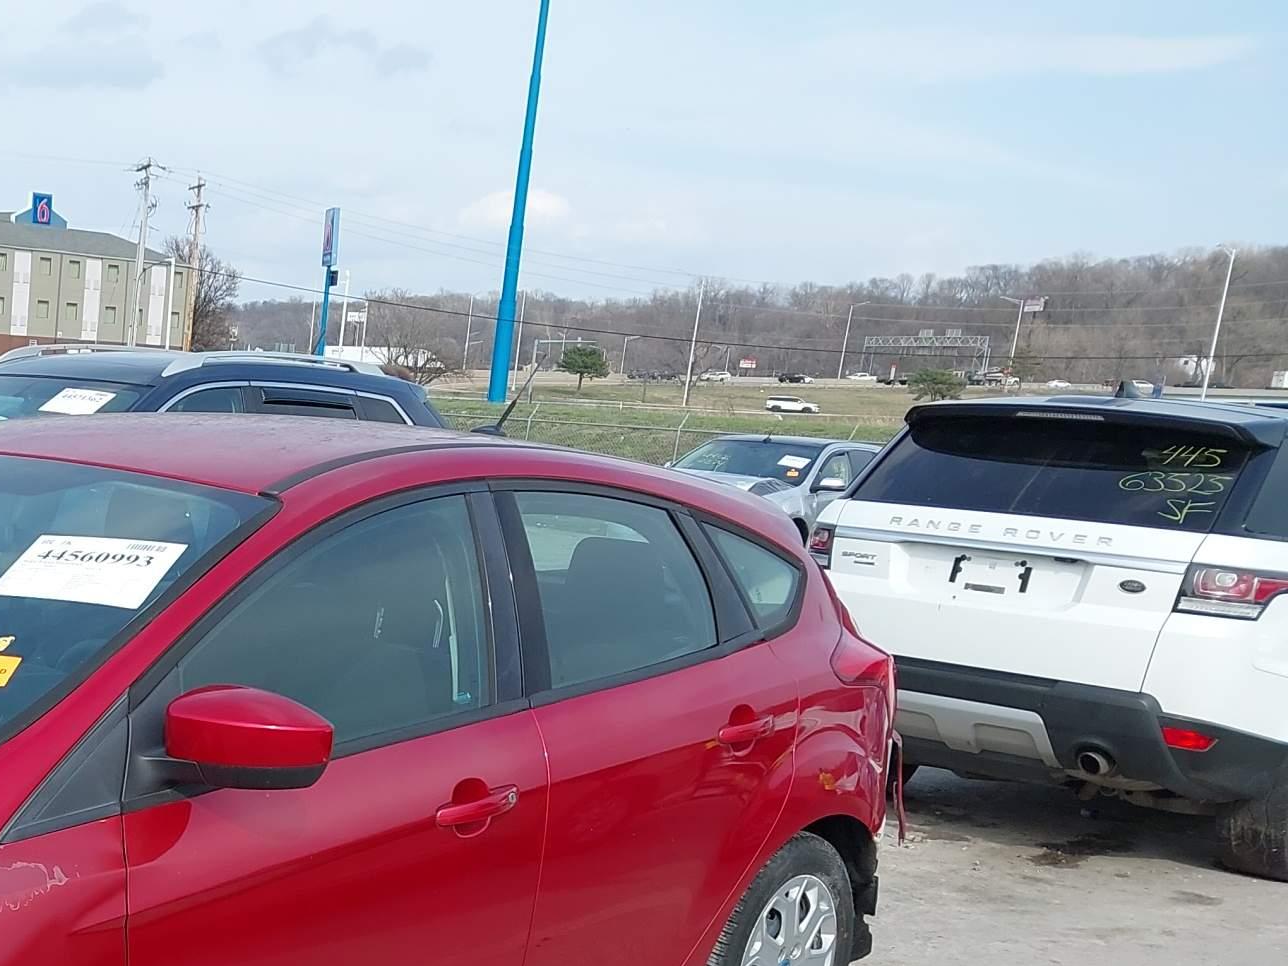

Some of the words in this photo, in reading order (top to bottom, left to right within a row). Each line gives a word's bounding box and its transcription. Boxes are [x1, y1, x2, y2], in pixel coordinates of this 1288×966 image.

[37, 198, 49, 222] 6
[1161, 445, 1228, 468] 445
[1157, 499, 1216, 524] SF
[889, 515, 983, 535] RANGE
[1002, 526, 1114, 548] ROVER
[37, 549, 155, 568] 44560993
[841, 550, 878, 560] SPORT
